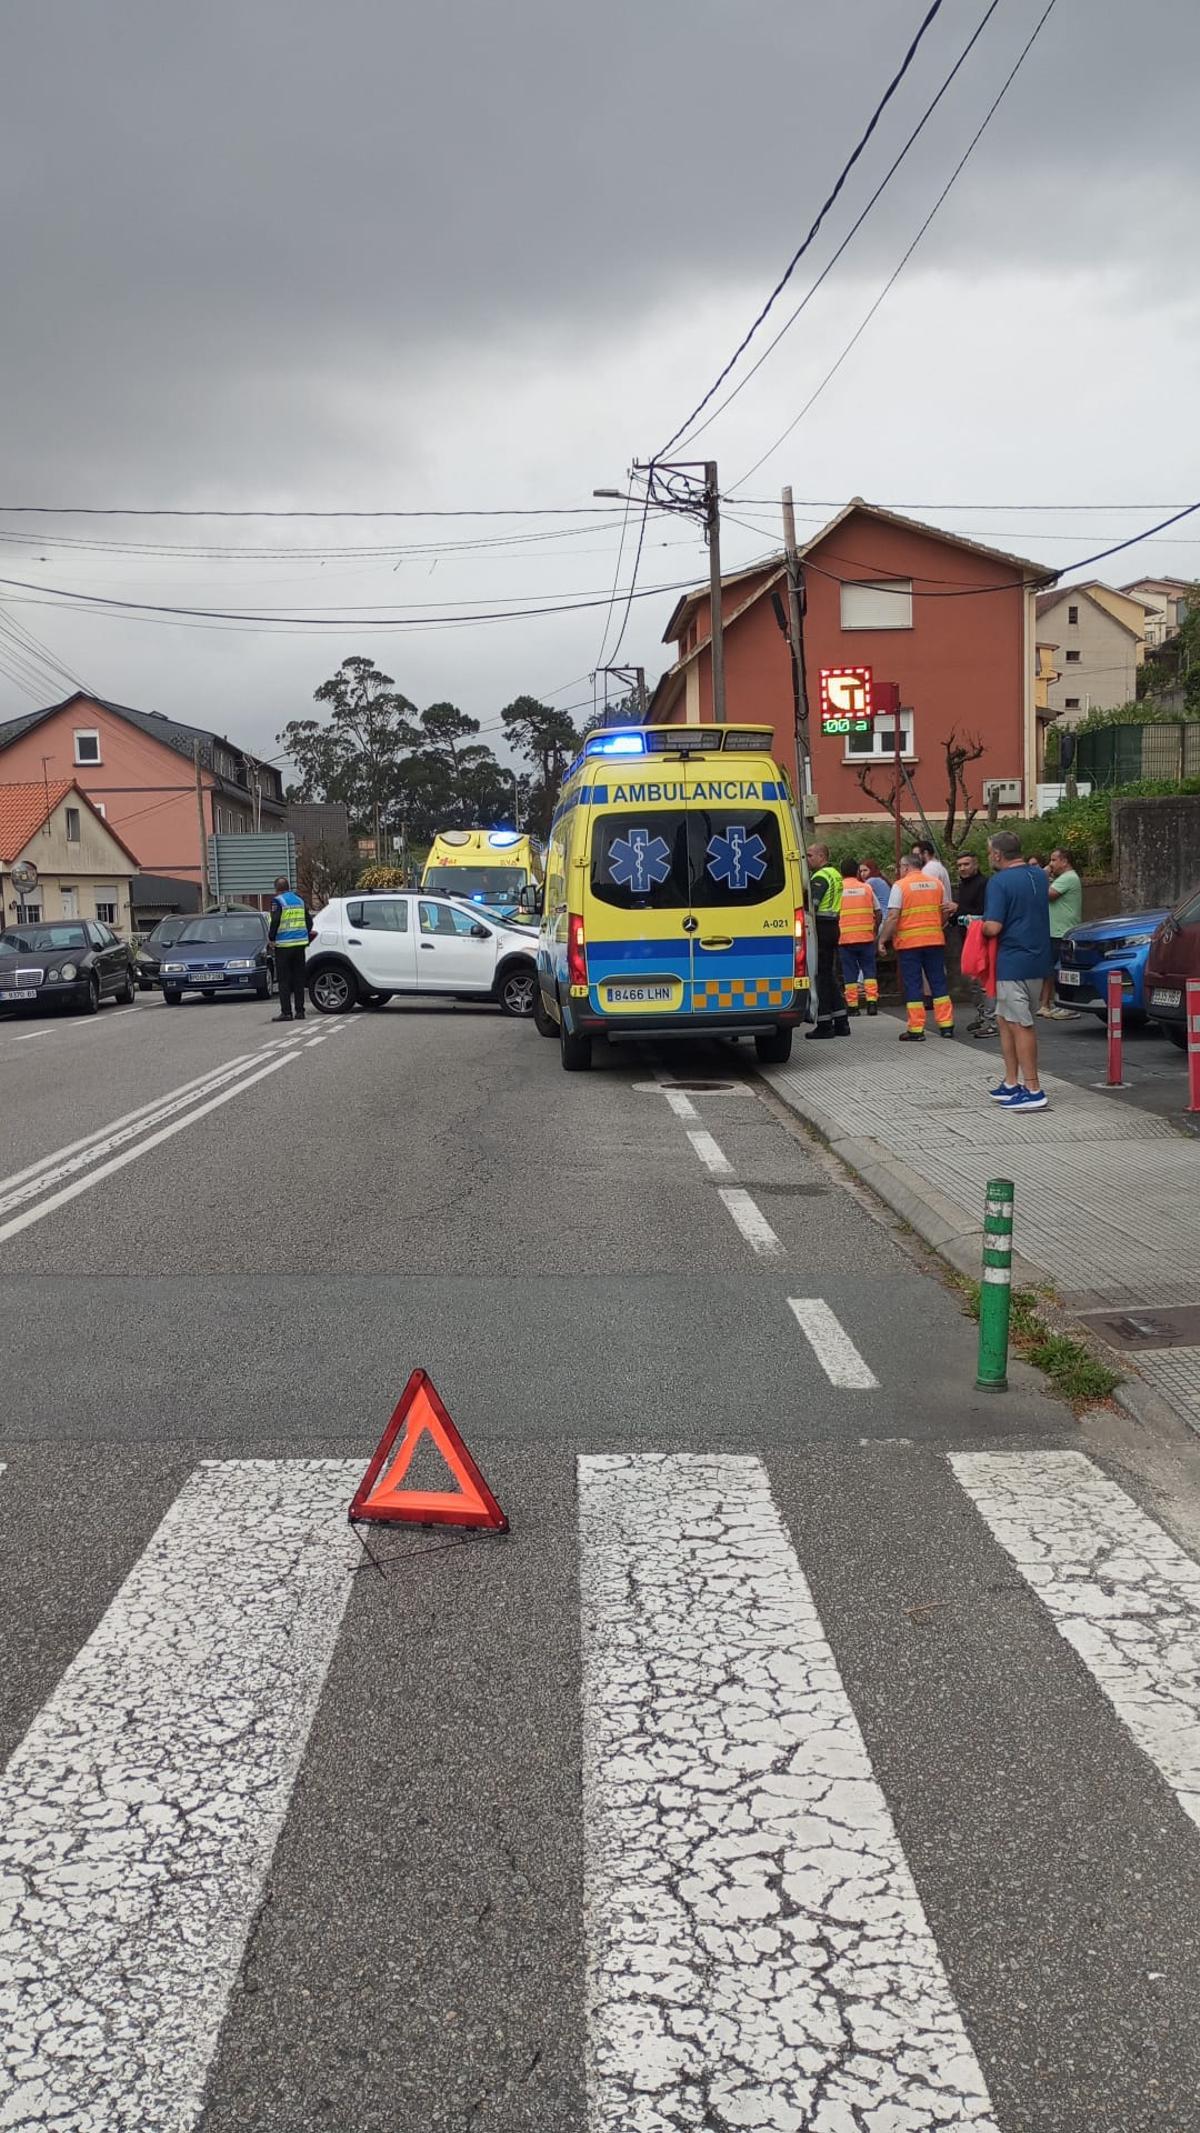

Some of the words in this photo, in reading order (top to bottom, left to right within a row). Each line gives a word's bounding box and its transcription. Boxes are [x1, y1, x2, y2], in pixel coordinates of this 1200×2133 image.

[855, 720, 868, 731] a
[613, 781, 760, 803] AMBULANCIA
[763, 919, 788, 928] A-021
[614, 989, 644, 1001] 8466
[647, 987, 670, 1000] LHN
